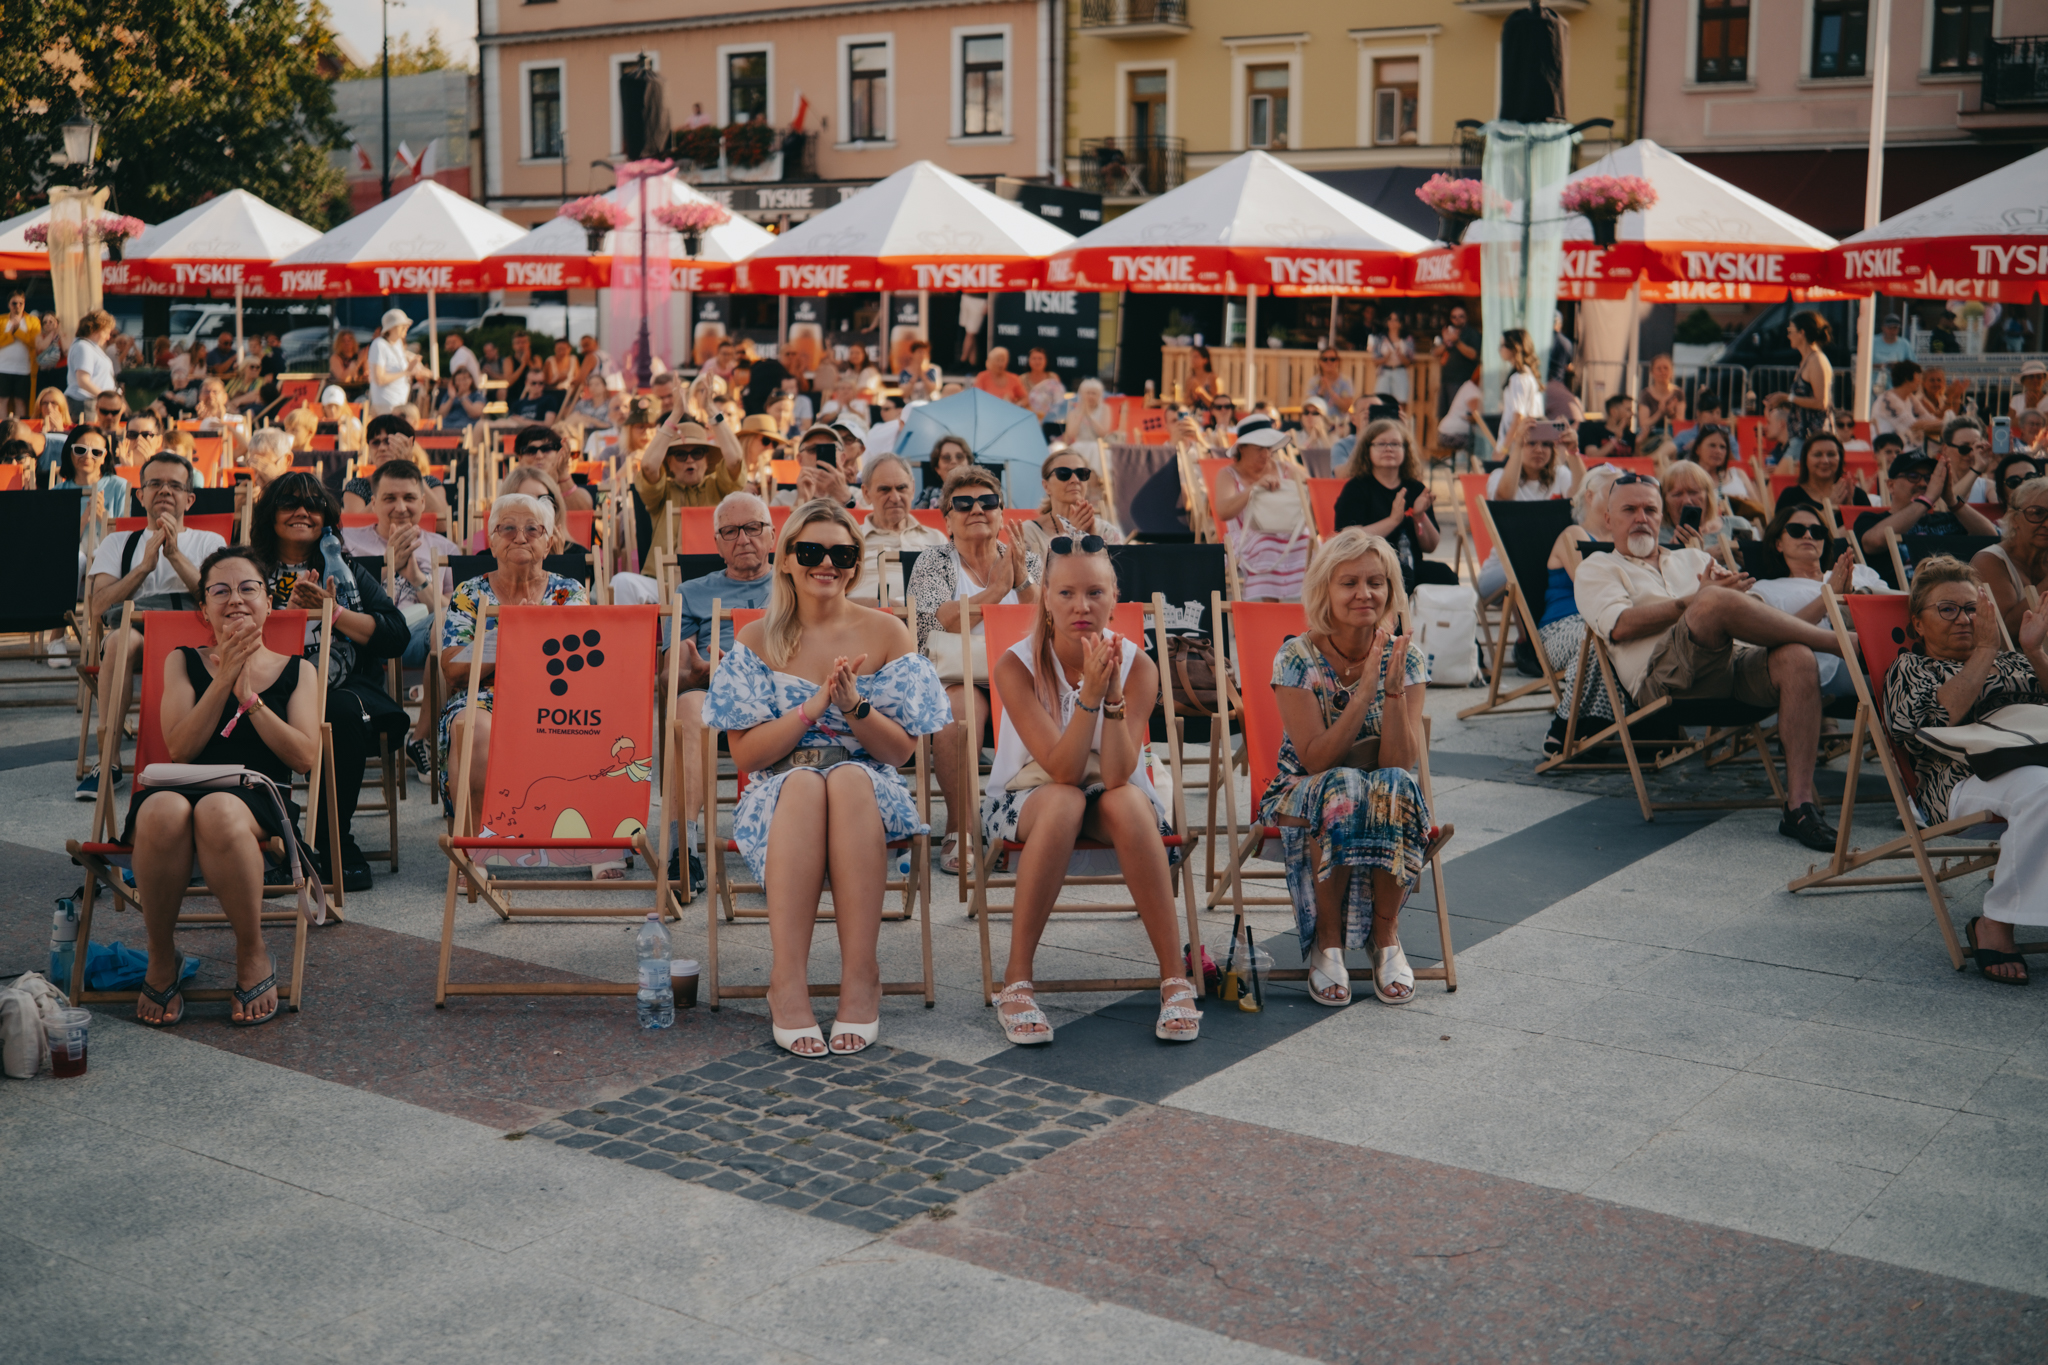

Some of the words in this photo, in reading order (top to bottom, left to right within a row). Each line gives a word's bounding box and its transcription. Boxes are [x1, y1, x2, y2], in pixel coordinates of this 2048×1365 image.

[756, 188, 814, 208] TYSKIE
[171, 263, 246, 284] TYSKIE
[503, 262, 564, 285] TYSKIE
[911, 263, 1004, 288] TYSKIE
[1108, 255, 1195, 282] TYSKIE
[1264, 256, 1363, 286] TYSKIE
[1414, 253, 1455, 284] TYSKIE
[1681, 250, 1785, 282] TYSKIE
[1843, 247, 1904, 280] TYSKIE
[280, 269, 328, 292] TYSKIE
[374, 266, 454, 288] TYSKIE
[775, 264, 850, 289] TYSKIE
[1024, 290, 1078, 315] TYSKIE
[537, 708, 602, 726] POKIS
[548, 728, 601, 736] THEMERSONÓW
